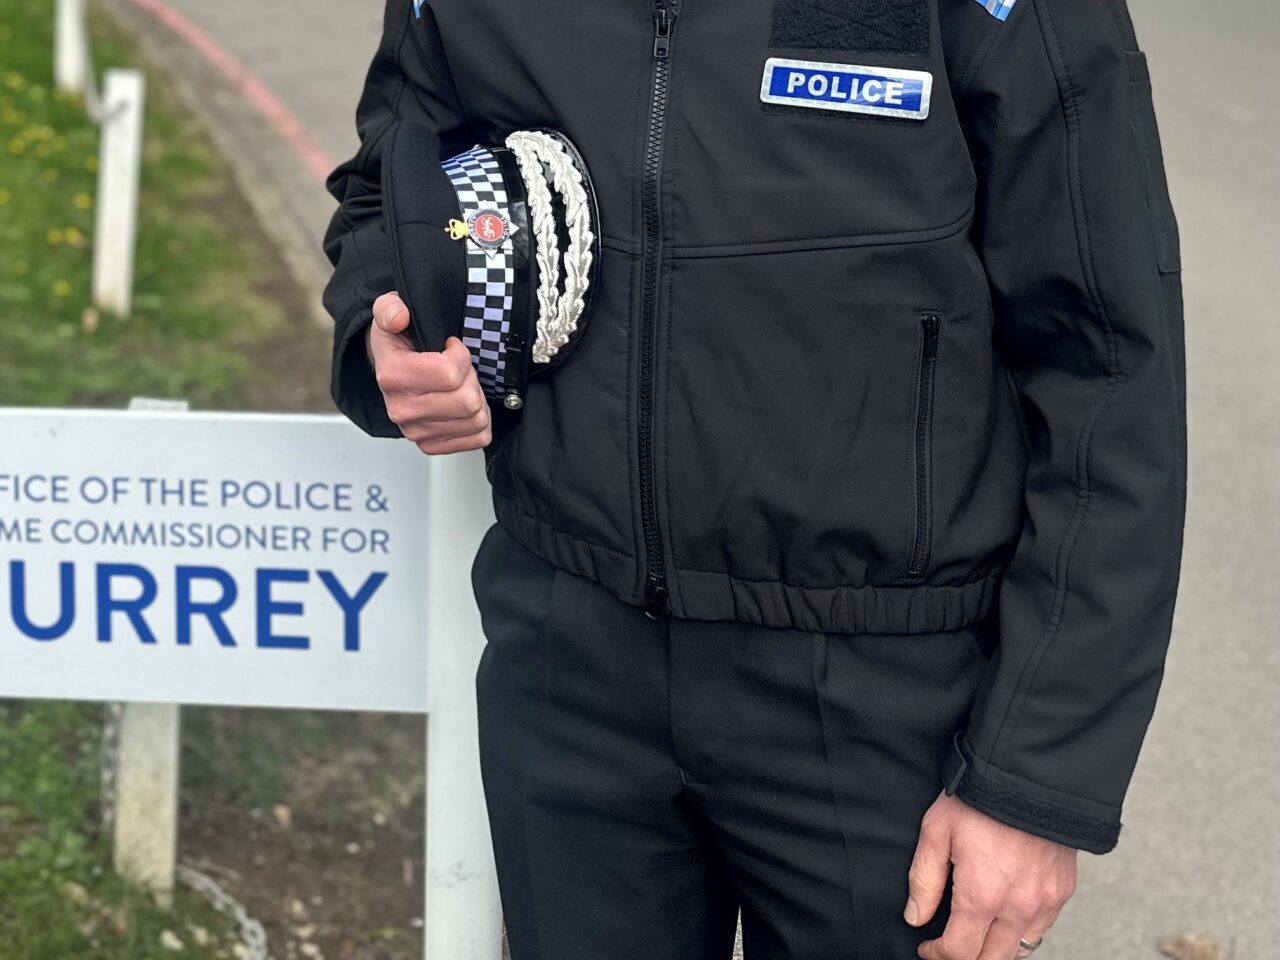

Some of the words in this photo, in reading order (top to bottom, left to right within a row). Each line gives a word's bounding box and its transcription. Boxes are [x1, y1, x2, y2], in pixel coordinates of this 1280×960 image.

[786, 71, 905, 106] POLICE
[79, 475, 131, 505] OF
[138, 477, 209, 508] THE
[220, 479, 353, 512] POLICE
[364, 483, 389, 513] &
[50, 518, 312, 552] COMMISSIONER
[321, 526, 391, 555] FOR
